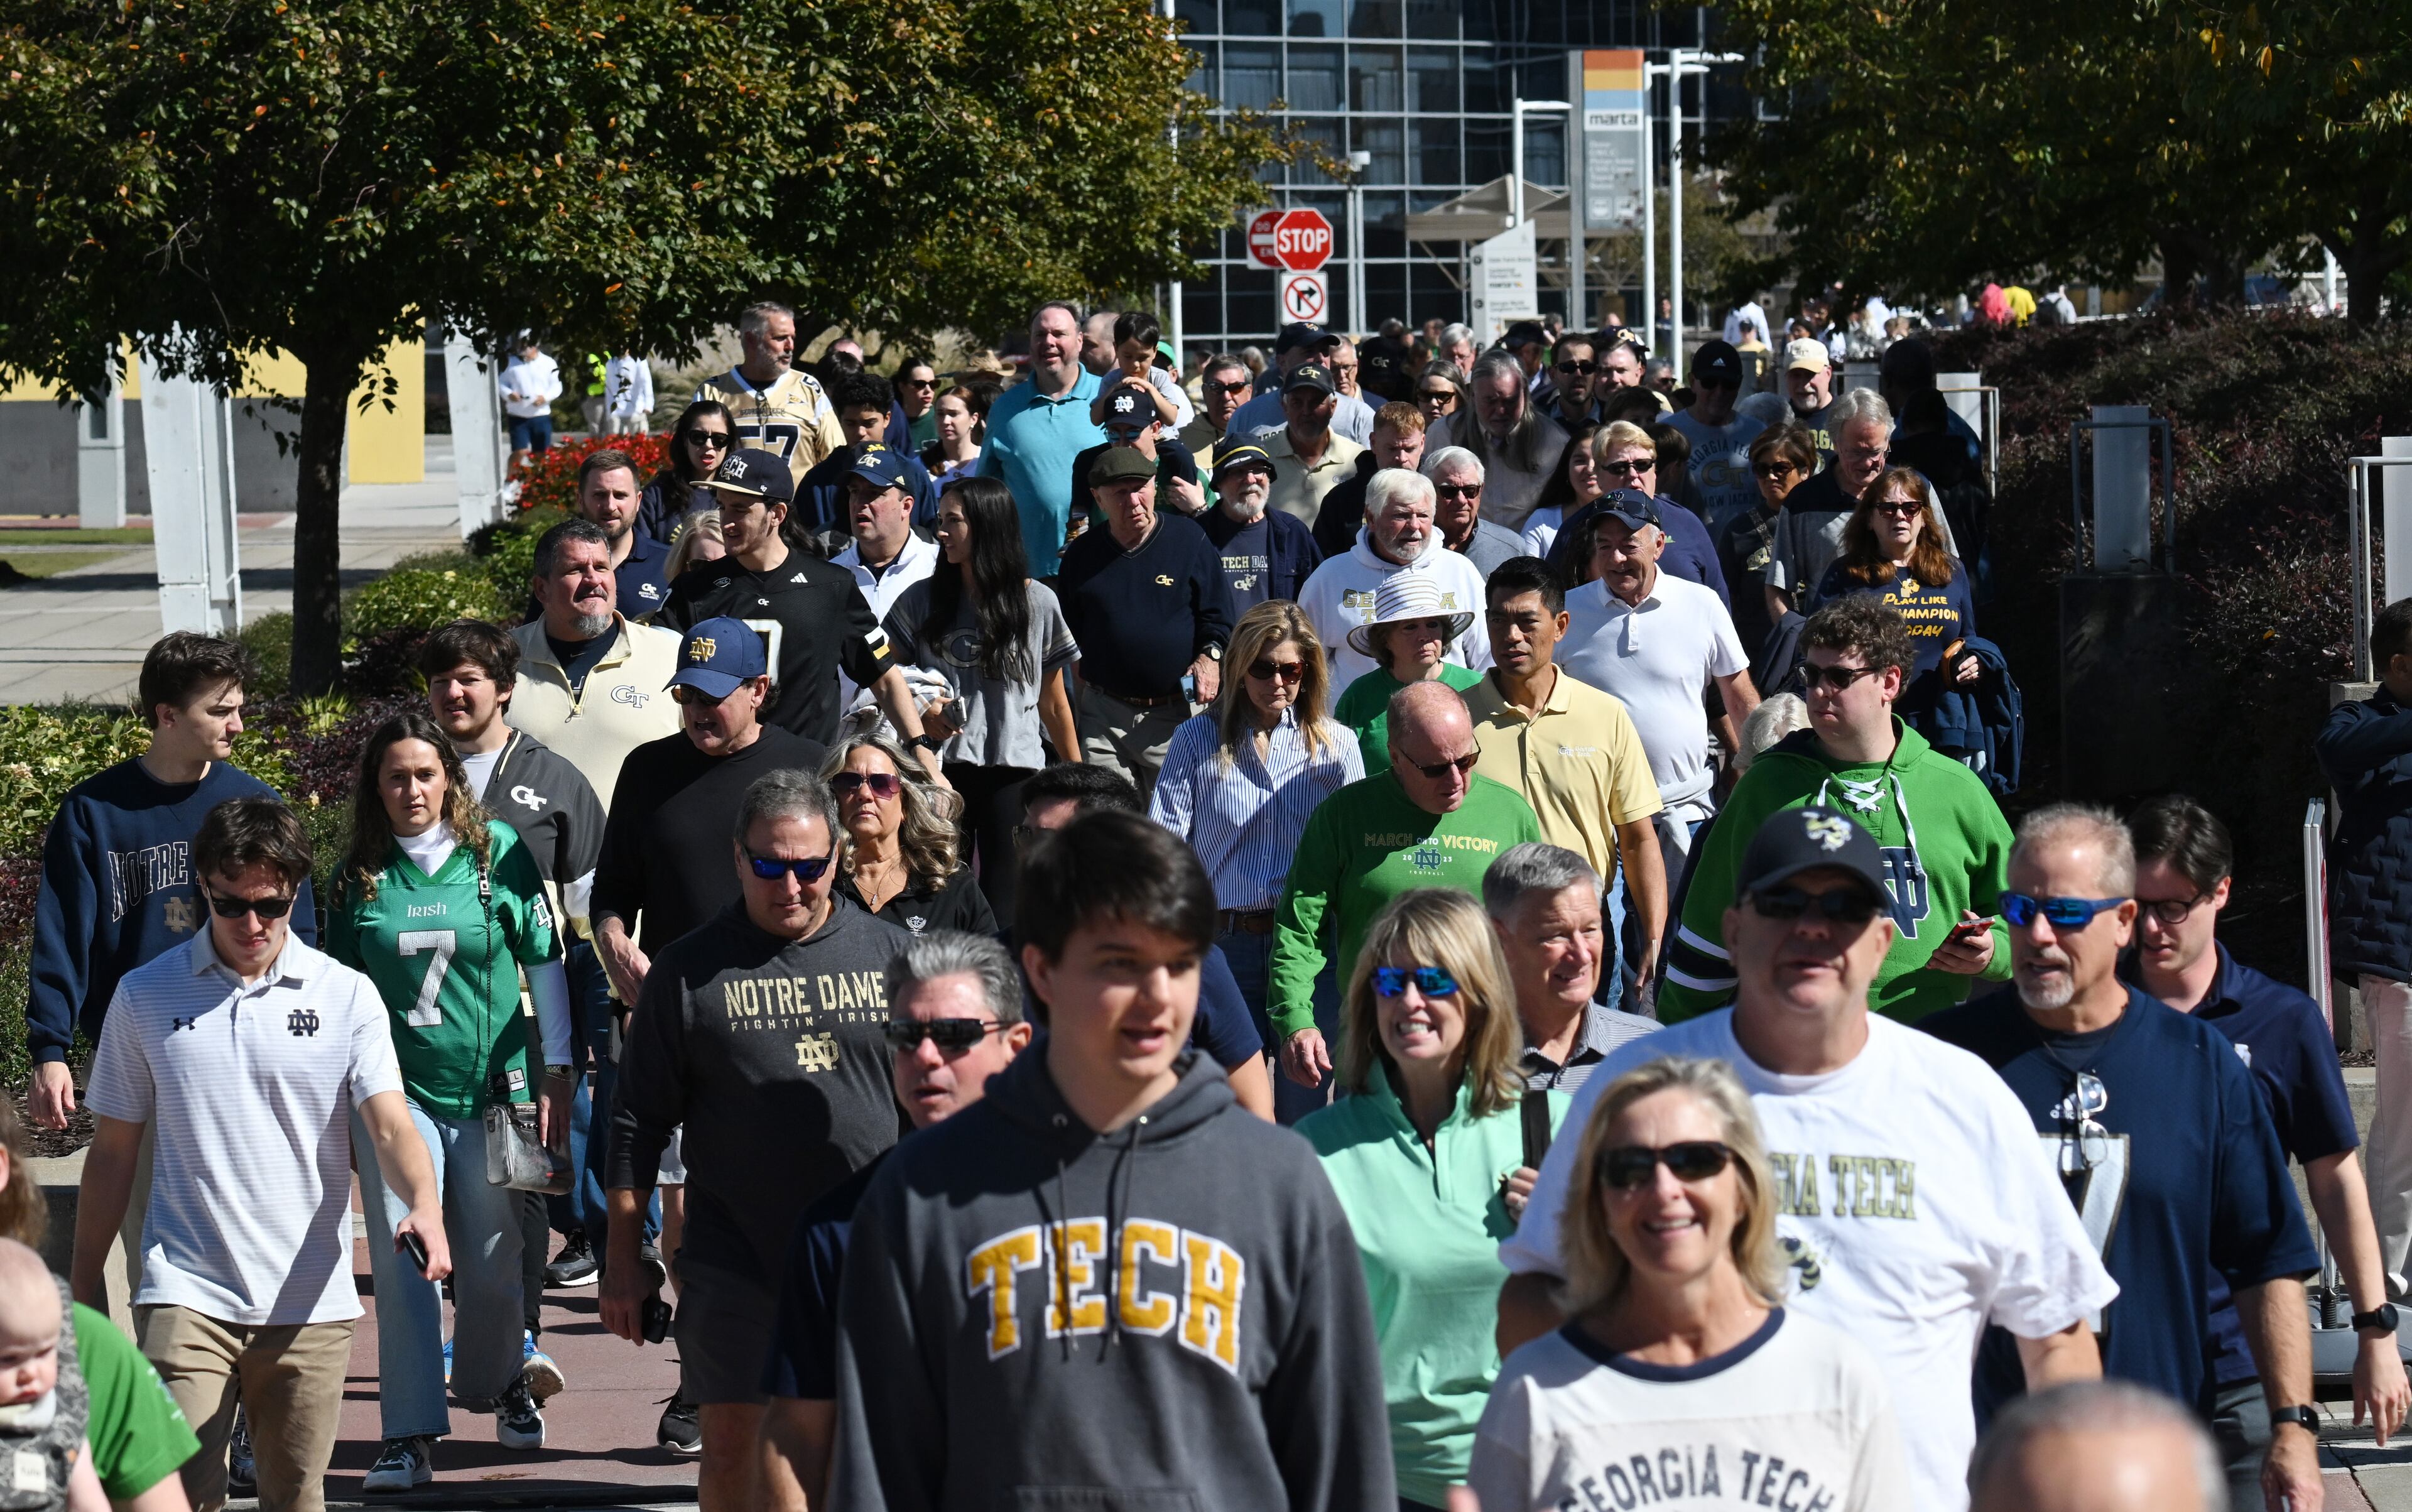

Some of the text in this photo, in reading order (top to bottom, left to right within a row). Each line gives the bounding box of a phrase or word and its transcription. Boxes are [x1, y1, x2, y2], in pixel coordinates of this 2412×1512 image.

[1589, 114, 1638, 126] marta
[1279, 228, 1329, 253] STOP
[1298, 366, 1321, 379] GT
[1371, 357, 1389, 368] GT
[1114, 396, 1134, 413] ND
[856, 454, 881, 468] GT
[1688, 438, 1750, 470] GEORGIA TEC
[1702, 459, 1749, 489] GT
[1221, 555, 1268, 569] TECH DA
[641, 583, 657, 594] GT
[1155, 574, 1174, 586] GT
[758, 598, 769, 607] GT
[1882, 592, 1948, 606] PLAY LIKE
[1898, 608, 1958, 623] HAMPION
[688, 636, 717, 663] ND
[611, 685, 649, 709] GT
[511, 785, 547, 812] GT
[1364, 833, 1413, 847] MARCH
[1442, 834, 1498, 855] VICTORY
[1412, 847, 1442, 870] ND
[108, 841, 188, 923] NOTRE
[397, 930, 456, 1027] 7
[724, 971, 889, 1019] NOTRE DAME
[288, 1009, 319, 1037] ND
[839, 1011, 889, 1023] IRISH
[795, 1031, 839, 1073] ND
[1828, 1155, 1916, 1220] TECH
[967, 1216, 1245, 1376] TECH
